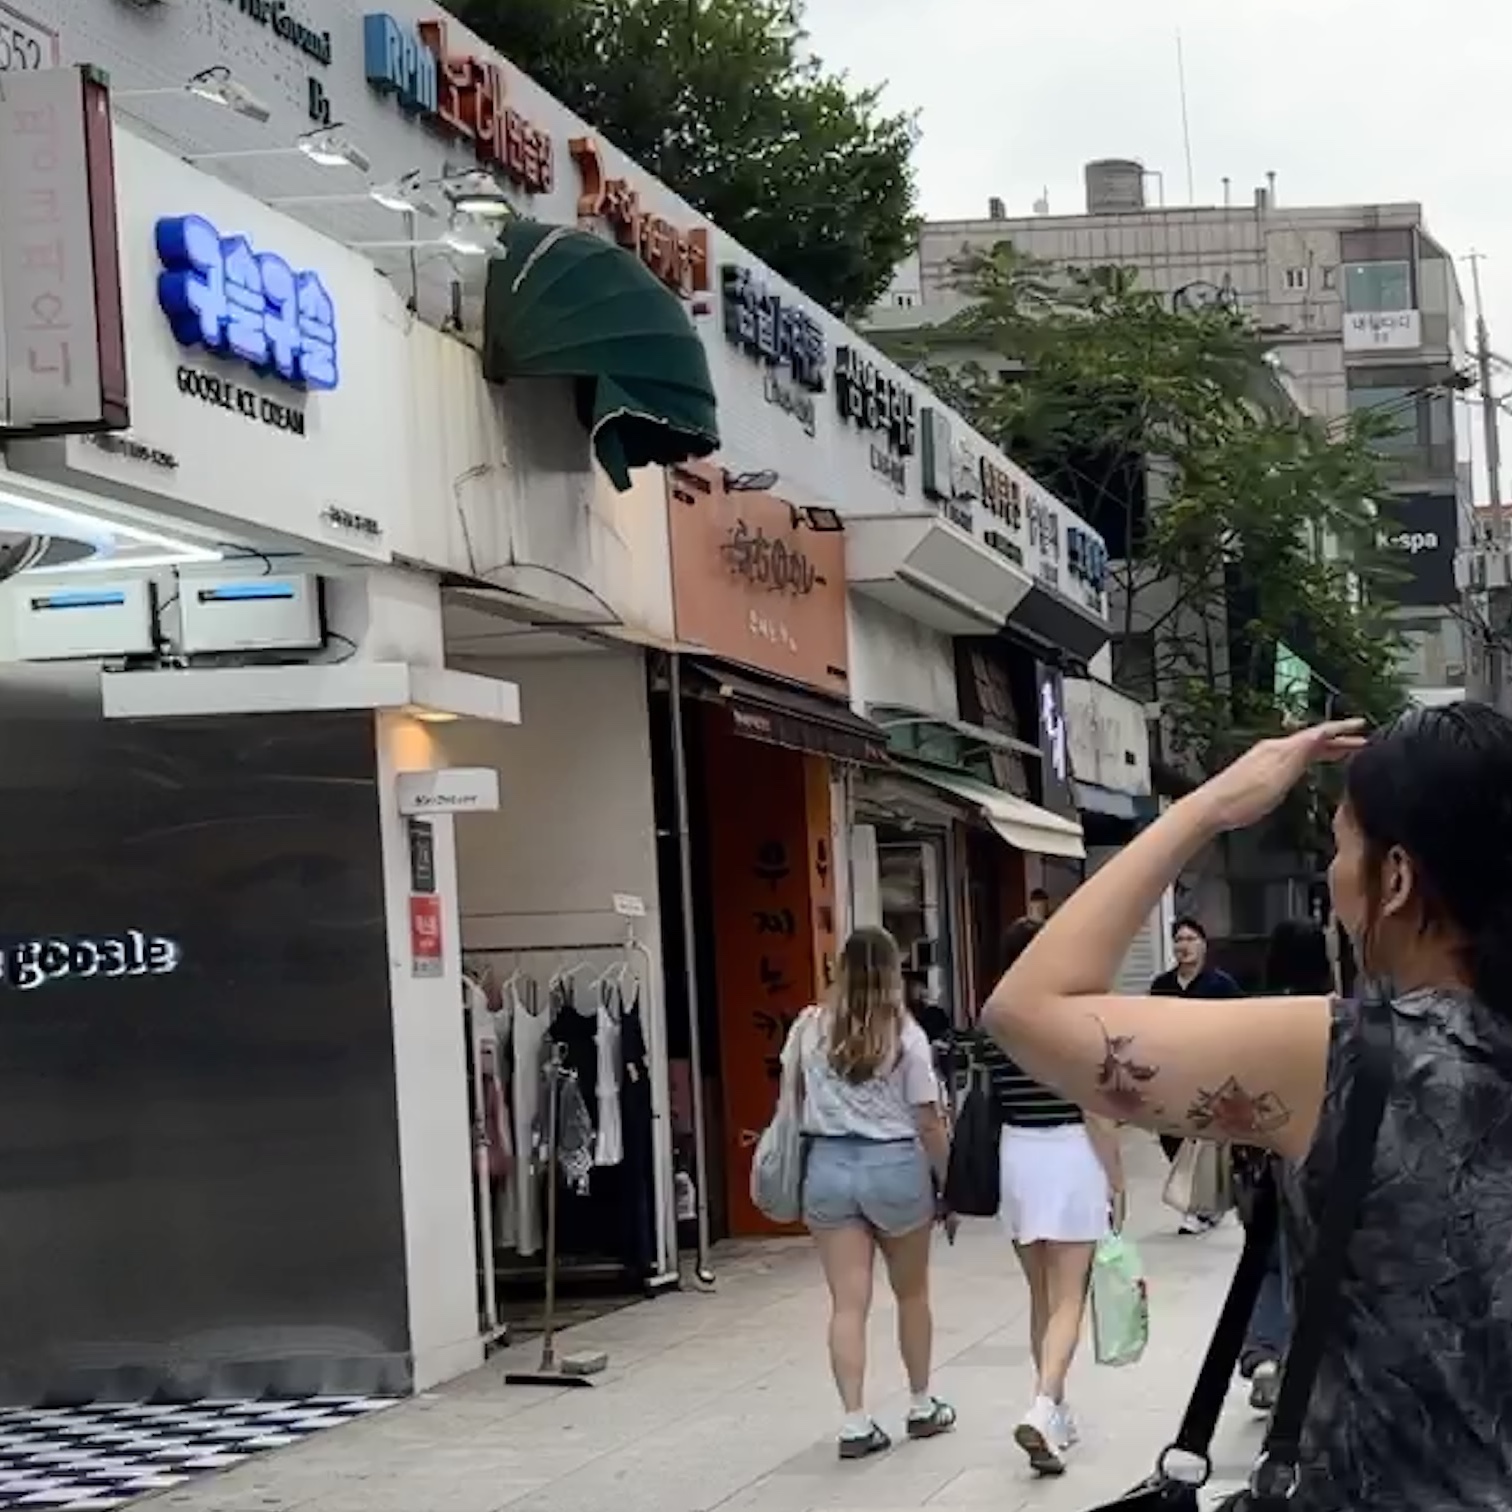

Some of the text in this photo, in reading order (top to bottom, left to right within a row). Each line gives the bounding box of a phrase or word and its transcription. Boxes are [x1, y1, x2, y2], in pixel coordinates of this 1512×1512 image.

[176, 365, 306, 437] GOOSLE ICE CREAM
[16, 927, 178, 990] goosle
